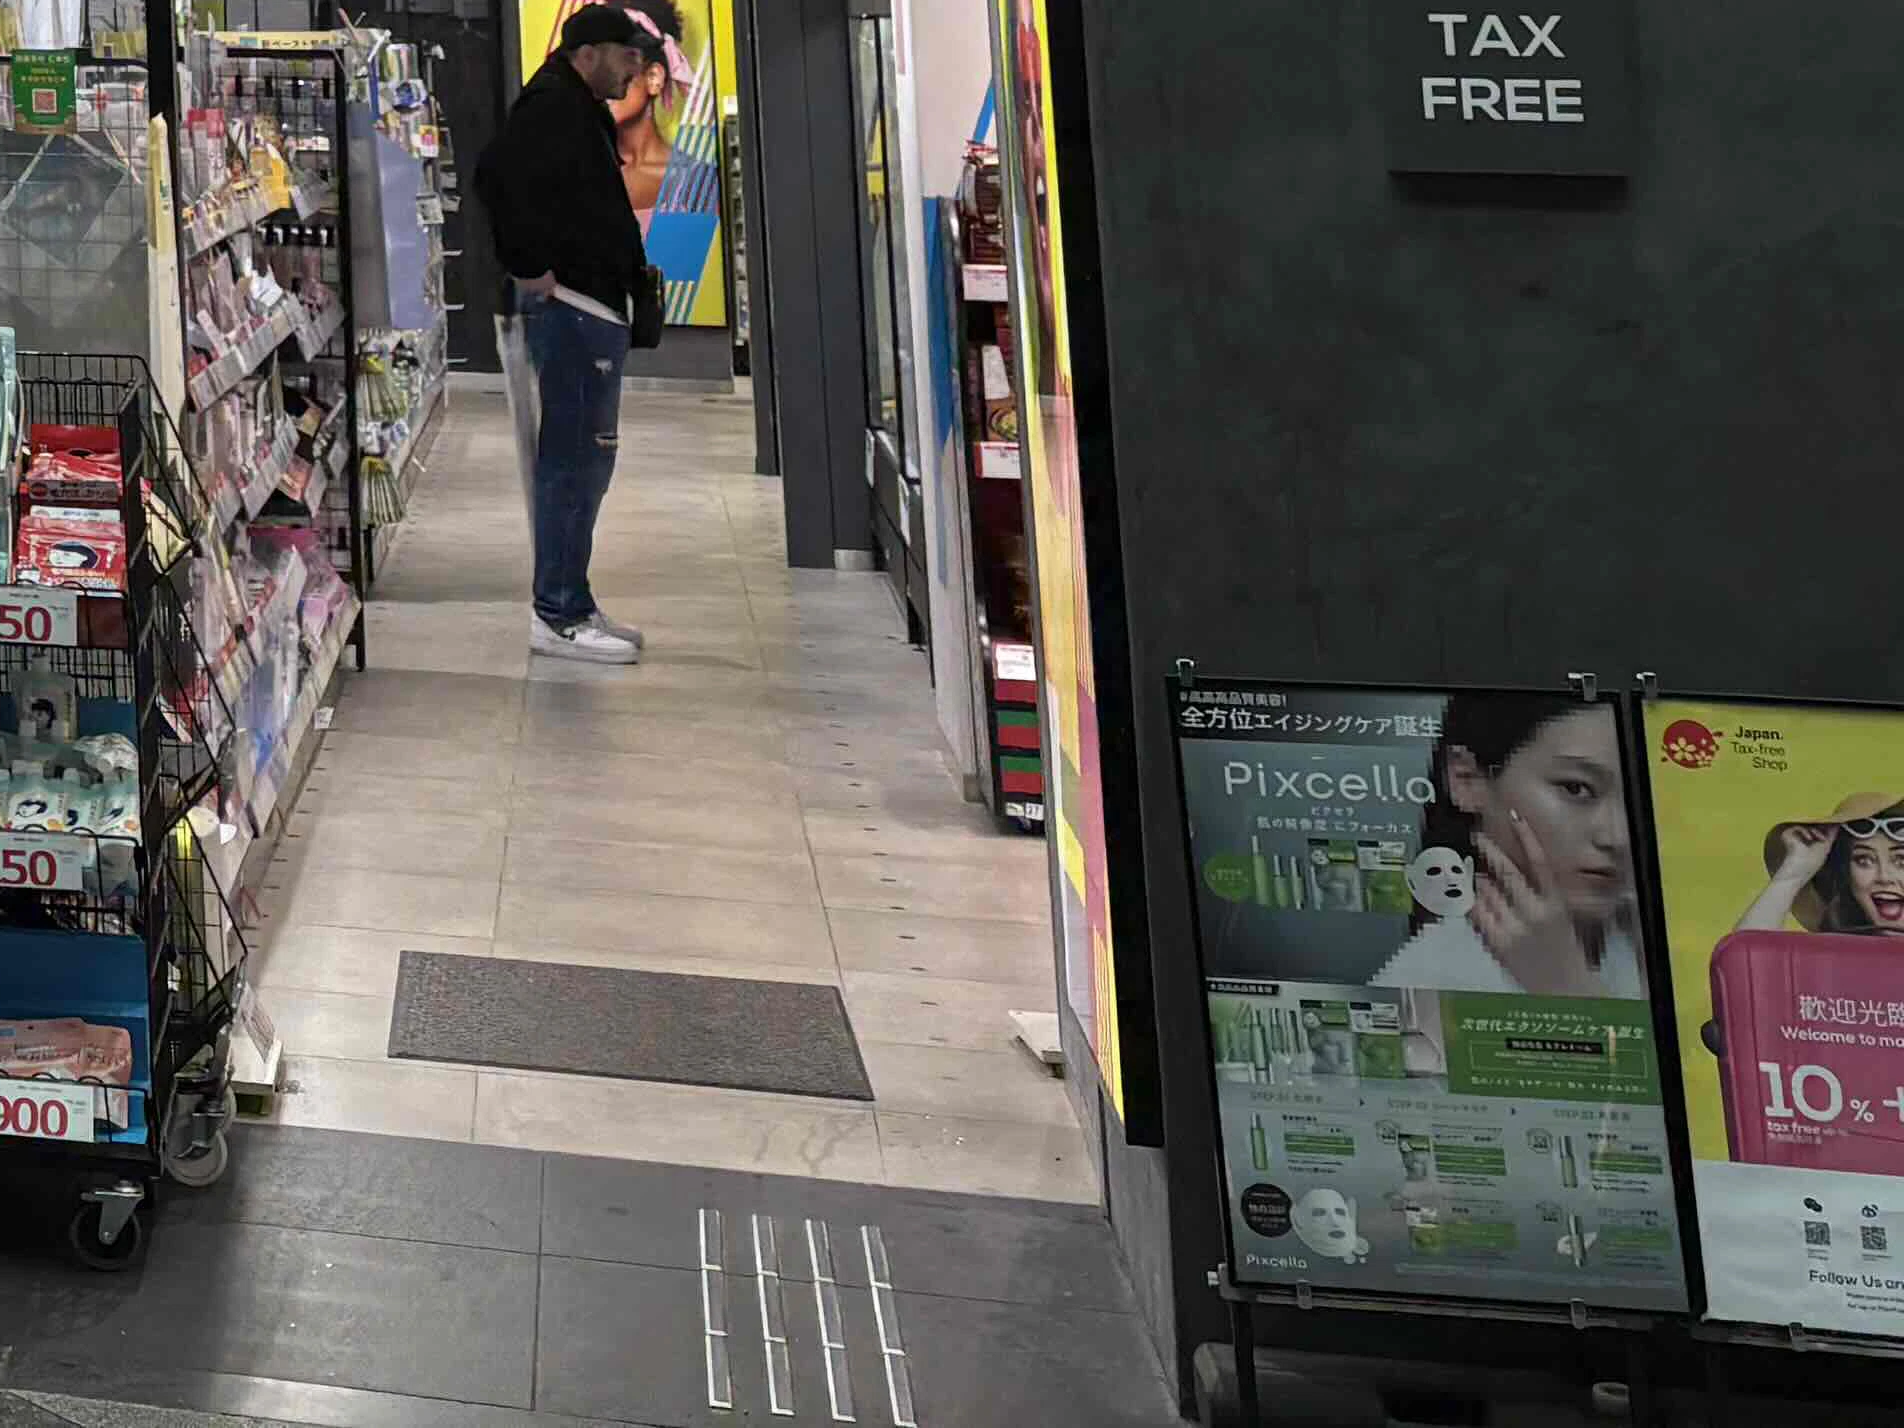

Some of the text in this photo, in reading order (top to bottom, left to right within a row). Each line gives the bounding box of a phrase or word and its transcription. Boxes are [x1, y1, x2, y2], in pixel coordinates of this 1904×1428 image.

[1428, 14, 1565, 58] TAX
[1422, 77, 1585, 122] FREE
[1180, 706, 1444, 738] 全方位エイジングケア誕生
[1735, 726, 1784, 742] Japan.
[1729, 741, 1786, 756] Tax-free
[1751, 756, 1788, 772] Shop
[1780, 1024, 1857, 1045] Welcome
[1859, 1032, 1877, 1047] to
[1767, 1120, 1790, 1134] tax
[1791, 1121, 1820, 1136] free
[1809, 1269, 1859, 1288] Follow
[1862, 1273, 1883, 1289] Us
